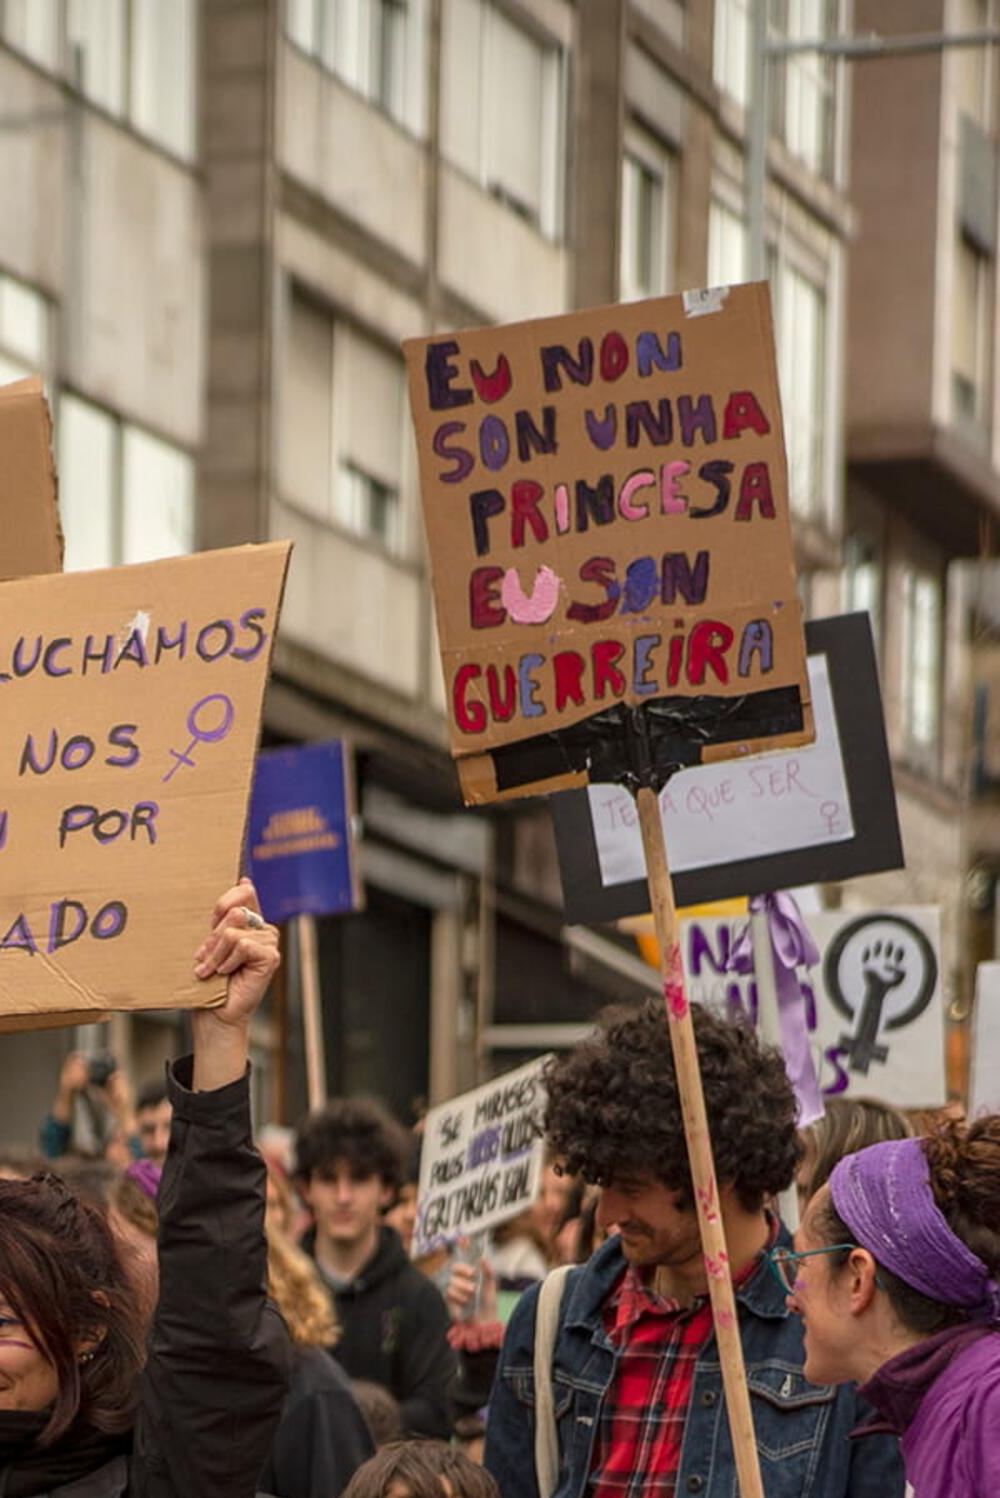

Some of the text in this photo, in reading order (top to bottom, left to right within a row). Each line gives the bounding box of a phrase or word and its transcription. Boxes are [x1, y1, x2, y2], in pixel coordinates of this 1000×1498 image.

[426, 331, 683, 411] EU NON
[432, 391, 770, 484] SON UNHA
[469, 459, 776, 557] PRINCESA
[469, 550, 711, 629] EU SON
[18, 723, 141, 777] NOS
[749, 758, 820, 799] SER
[58, 800, 160, 848] POR
